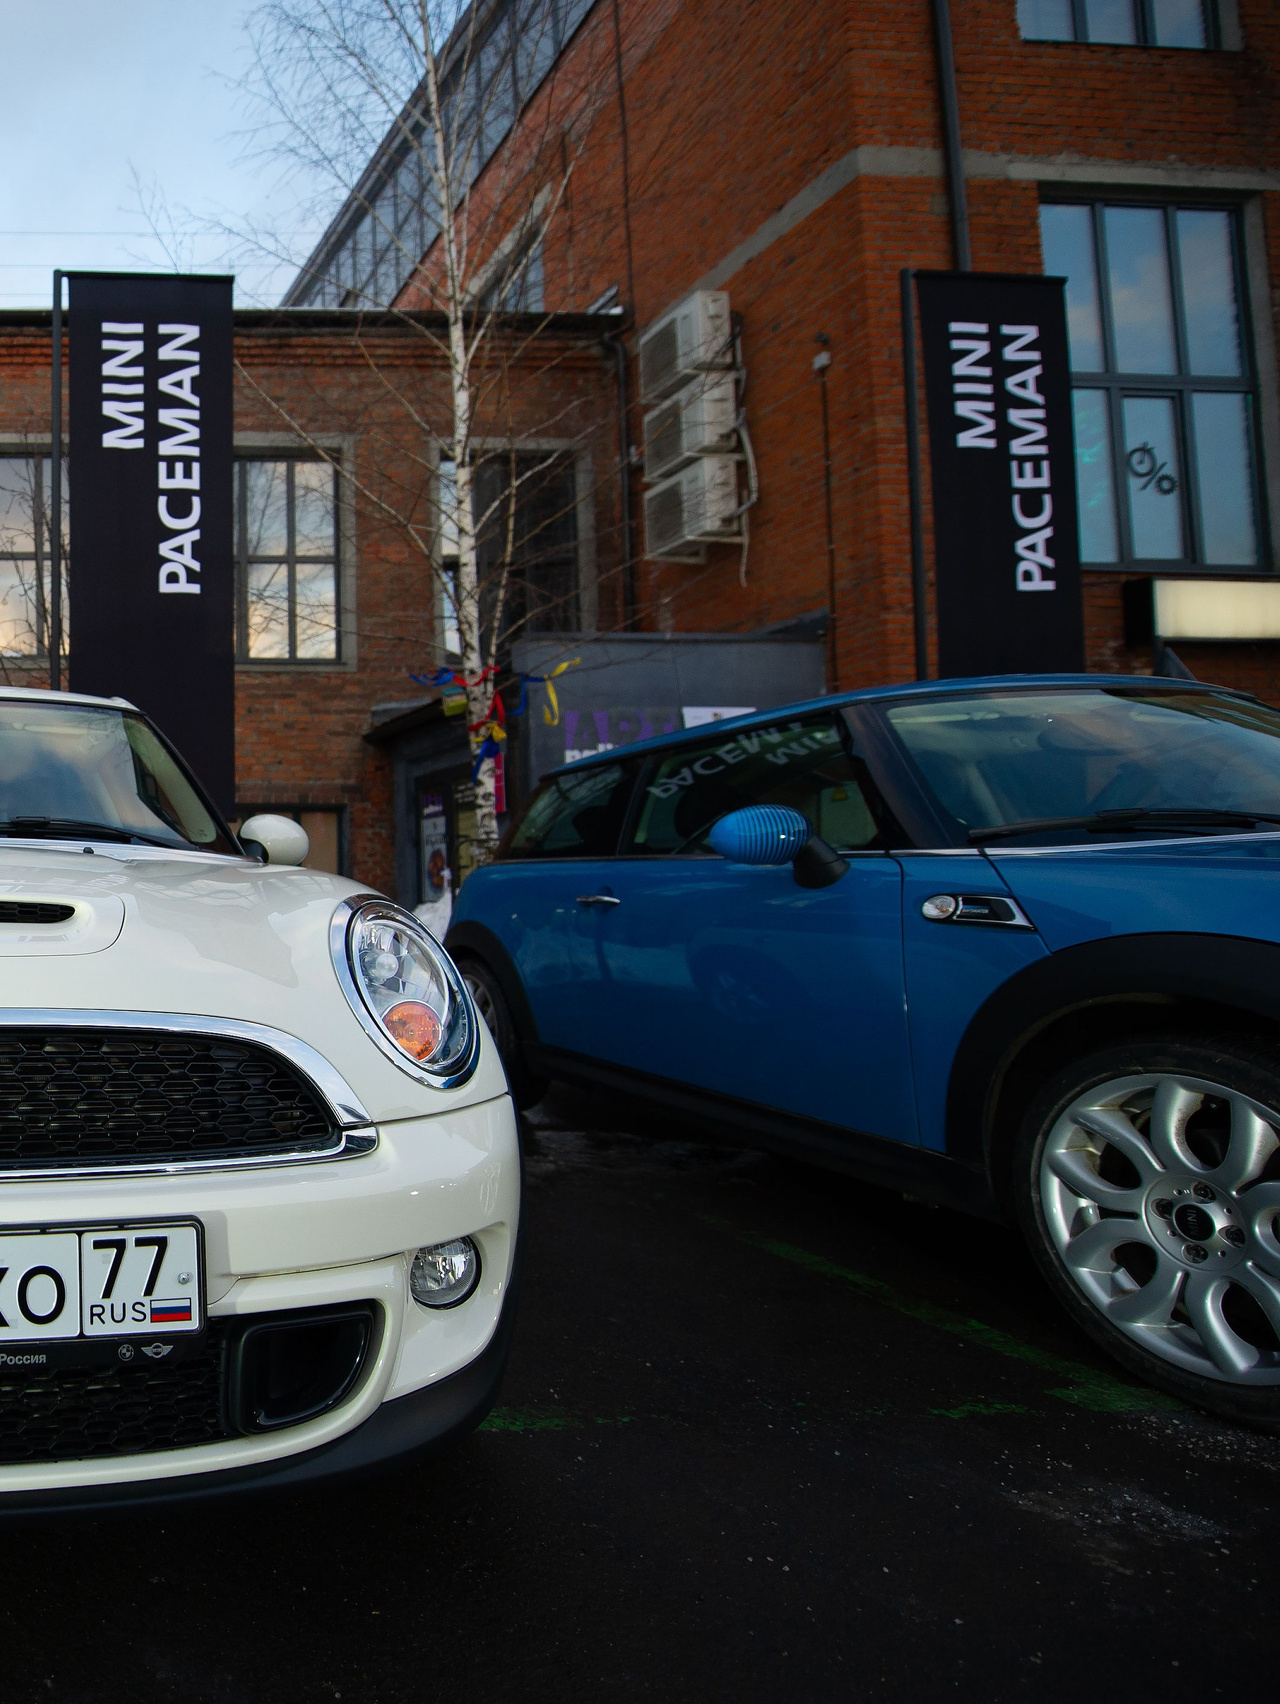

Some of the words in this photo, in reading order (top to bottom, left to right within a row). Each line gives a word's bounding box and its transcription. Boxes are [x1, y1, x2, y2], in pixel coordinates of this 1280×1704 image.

[101, 322, 145, 449] MINI
[948, 321, 997, 449] MINI
[157, 323, 201, 594] PACEMAN
[999, 323, 1057, 592] PACEMAN
[89, 1300, 147, 1326] RUS
[92, 1235, 169, 1299] 77
